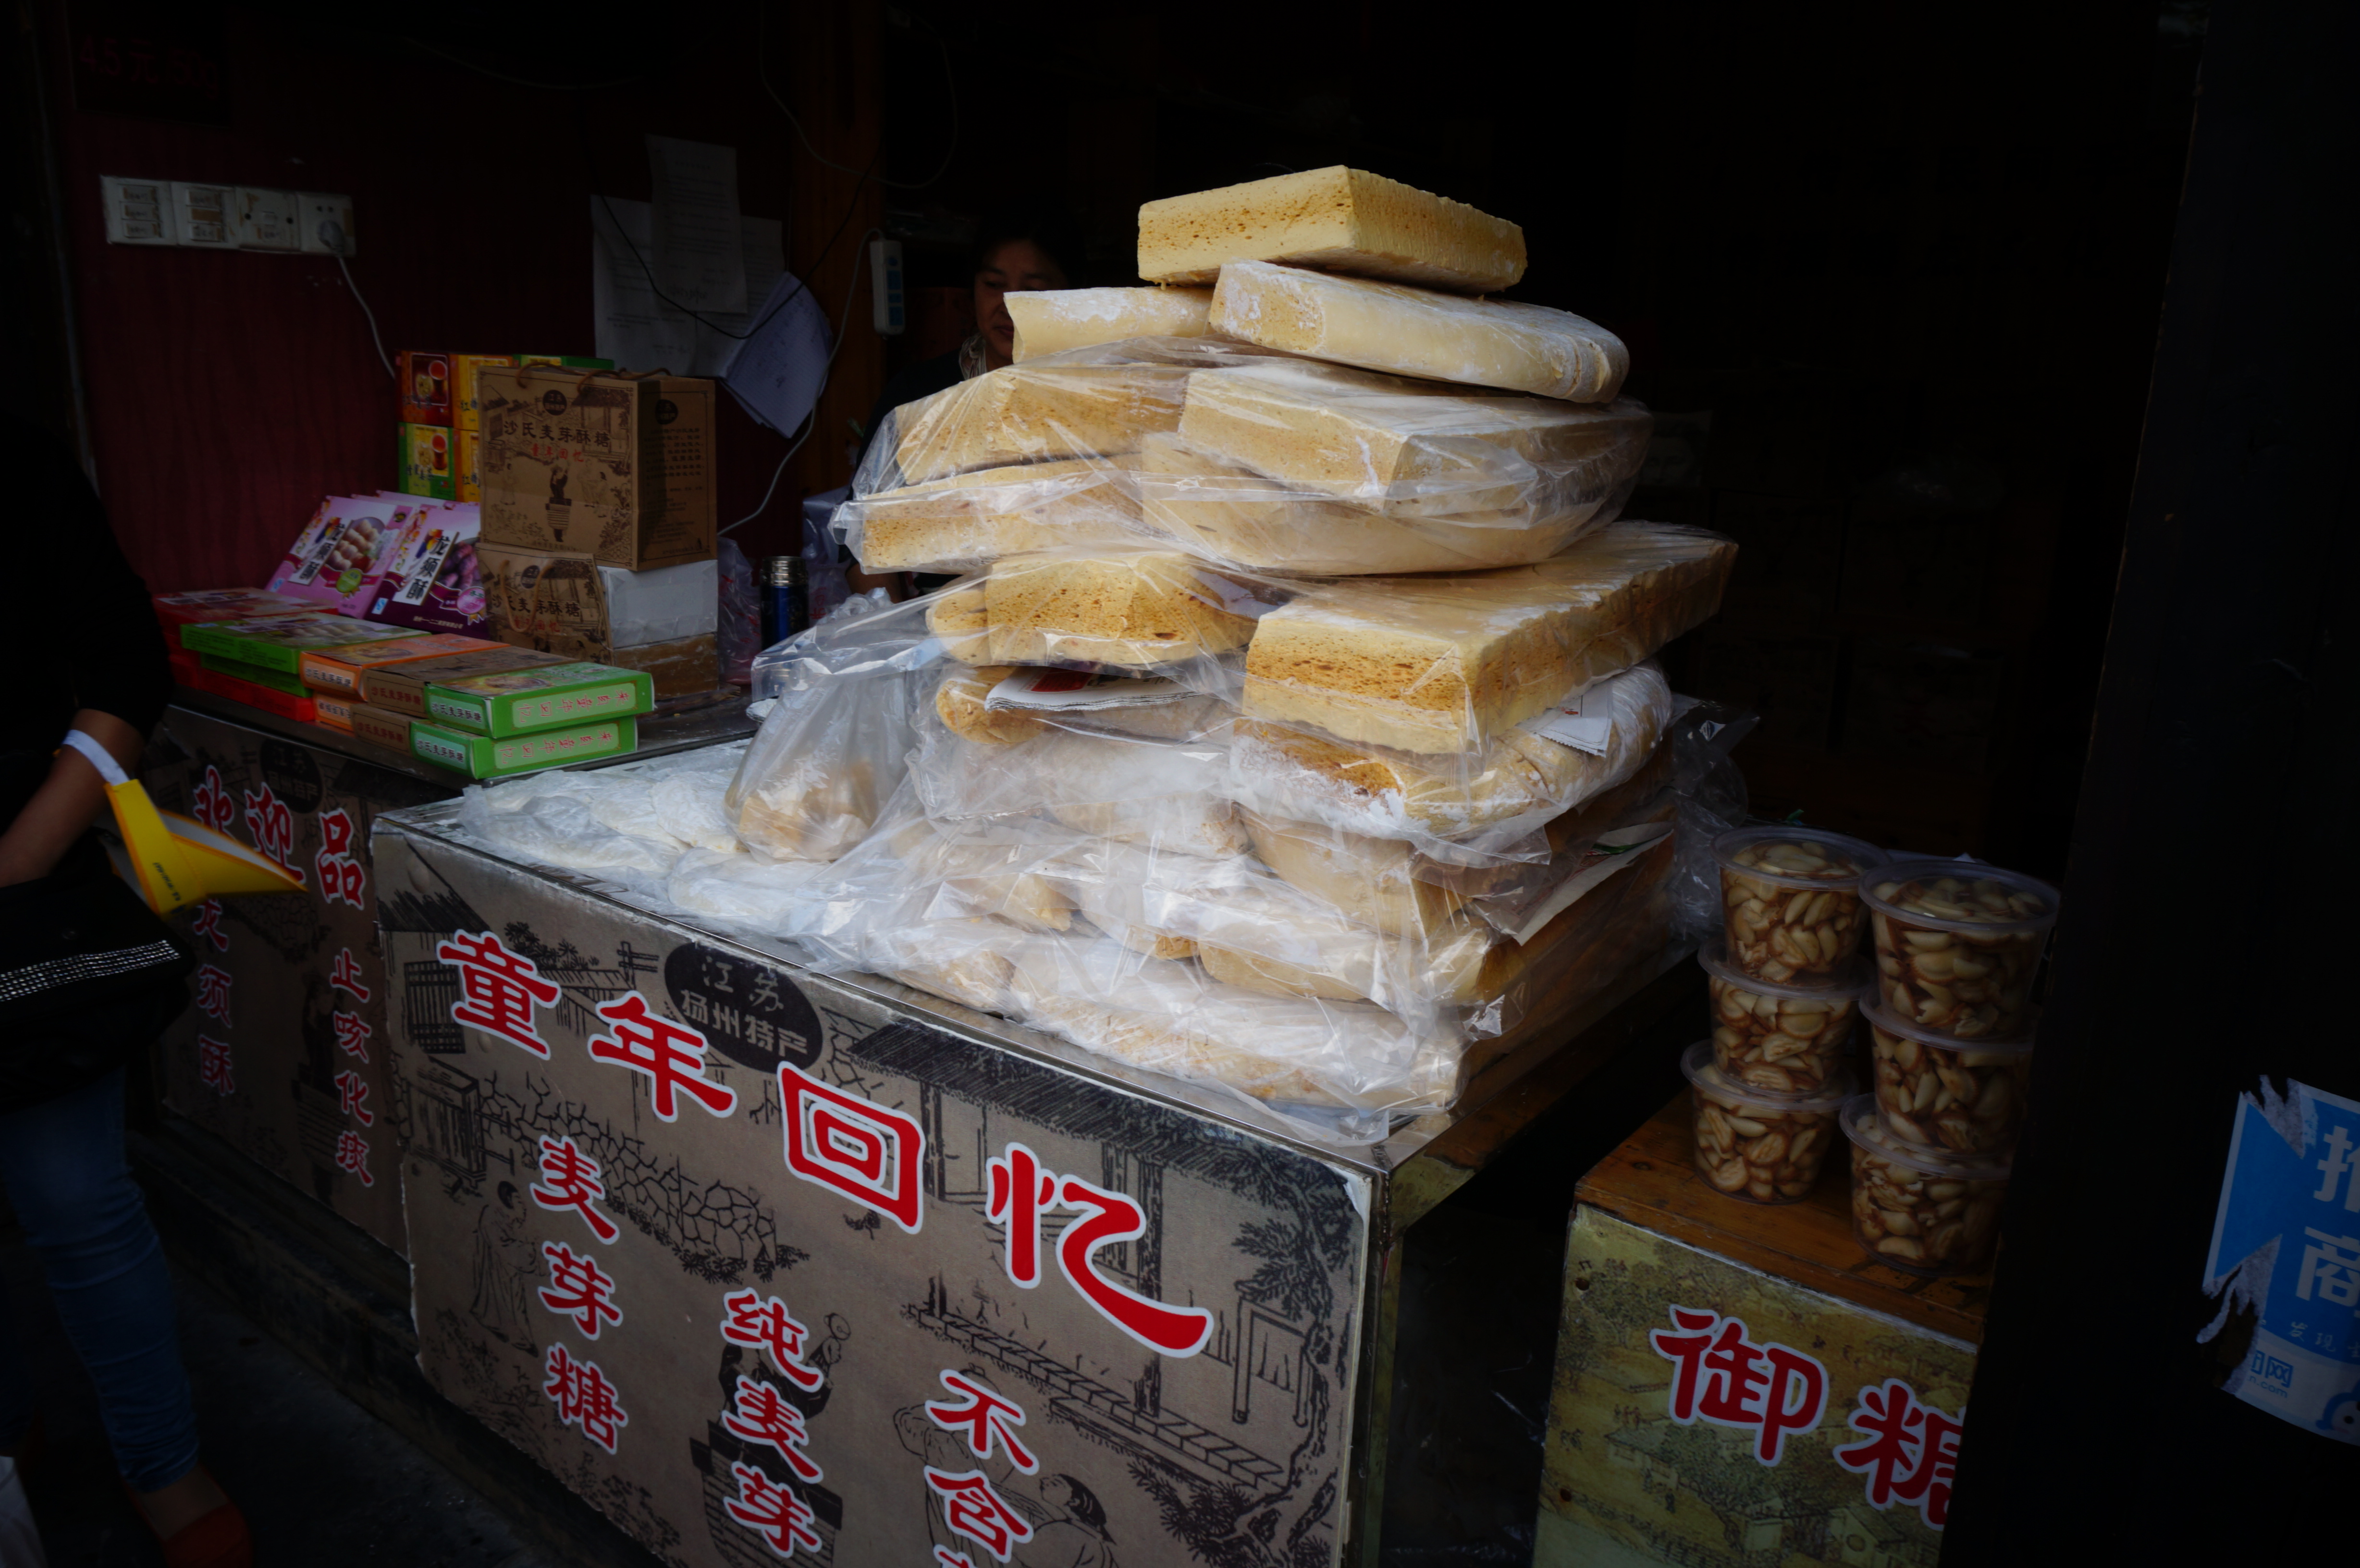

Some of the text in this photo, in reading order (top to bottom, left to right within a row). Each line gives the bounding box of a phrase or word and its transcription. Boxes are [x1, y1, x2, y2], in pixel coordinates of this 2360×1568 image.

[330, 947, 374, 1187] 止咳化痰
[680, 989, 809, 1057] 扬州特产
[701, 955, 785, 1012] 江苏
[436, 929, 1213, 1358] 童年回忆
[530, 1136, 629, 1454] 麦芽糖
[722, 1288, 824, 1557] 纯麦芽
